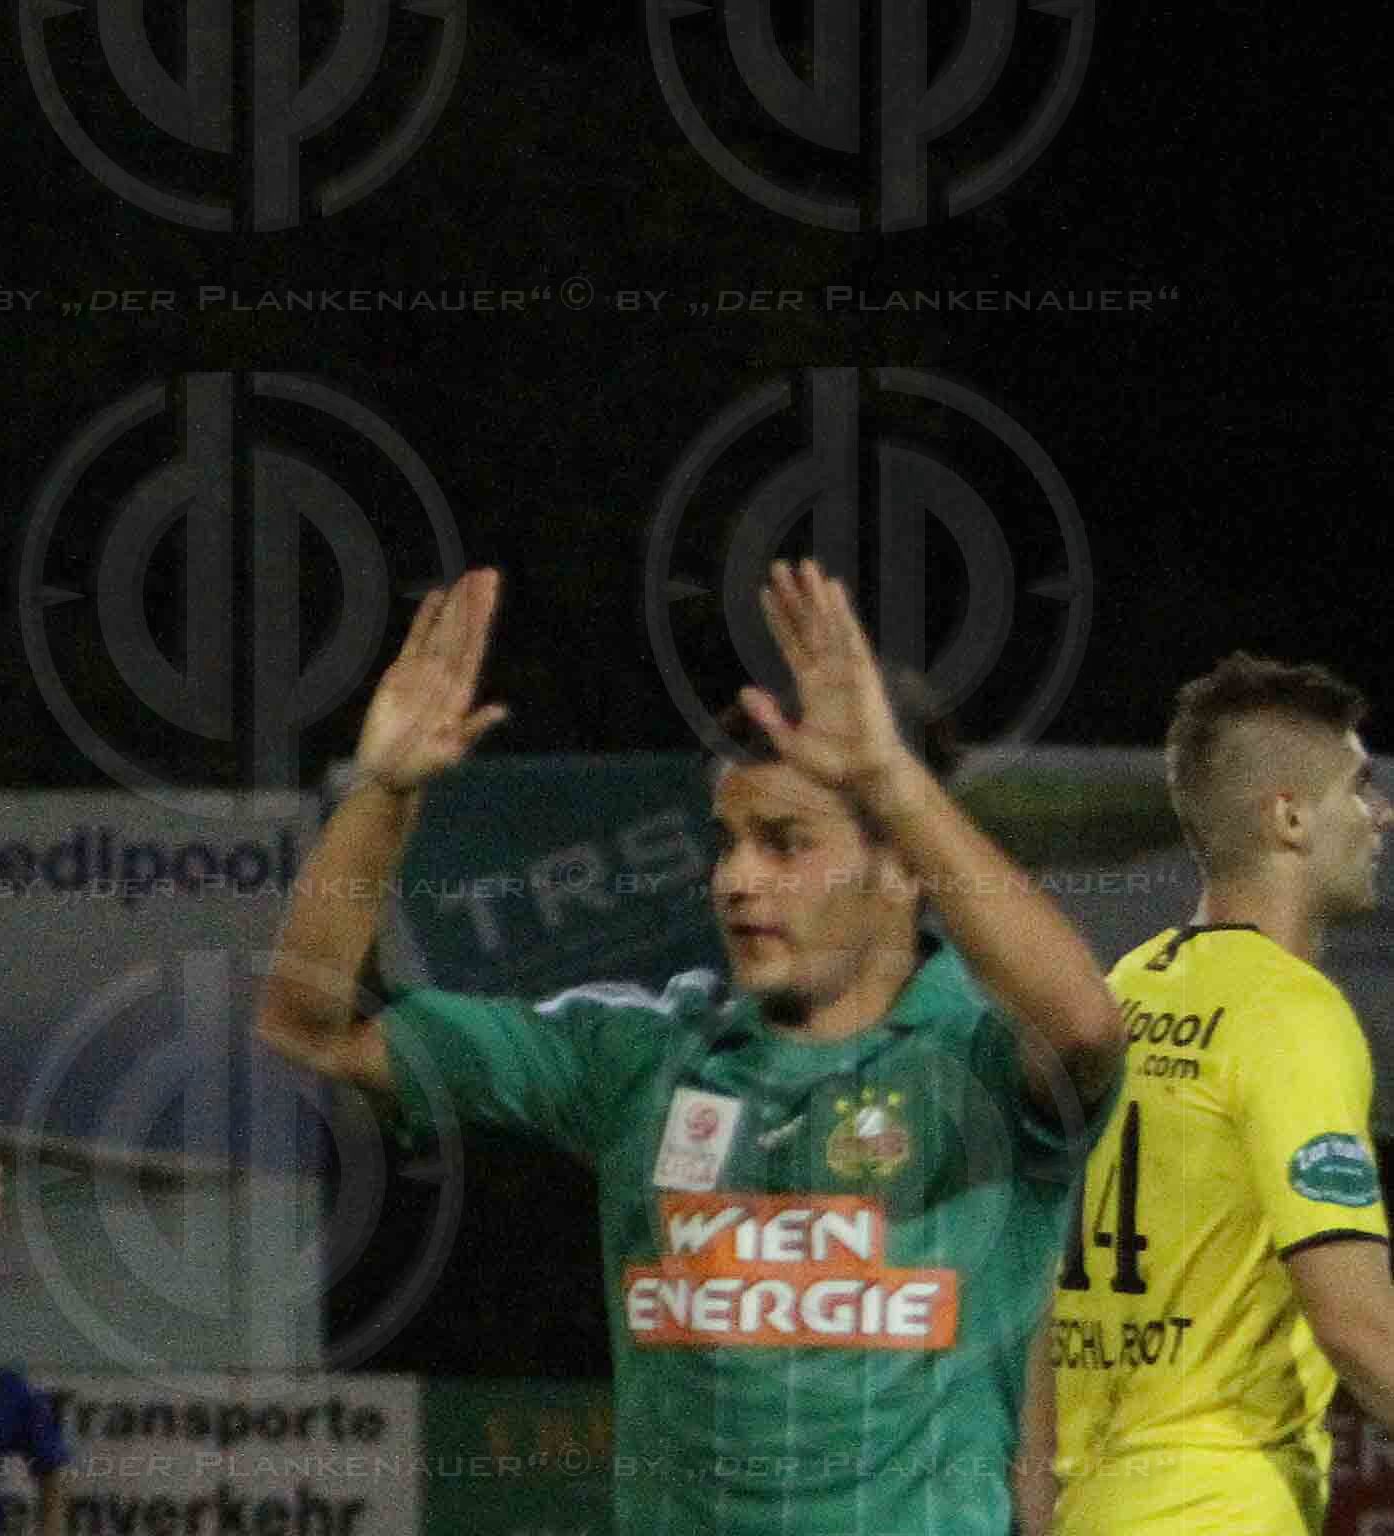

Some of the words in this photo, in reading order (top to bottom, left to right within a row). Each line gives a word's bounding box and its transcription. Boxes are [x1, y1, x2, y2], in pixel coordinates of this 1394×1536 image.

[668, 1205, 873, 1263] WIEN
[626, 1277, 940, 1336] ENERGIE
[51, 1391, 384, 1446] Transporte
